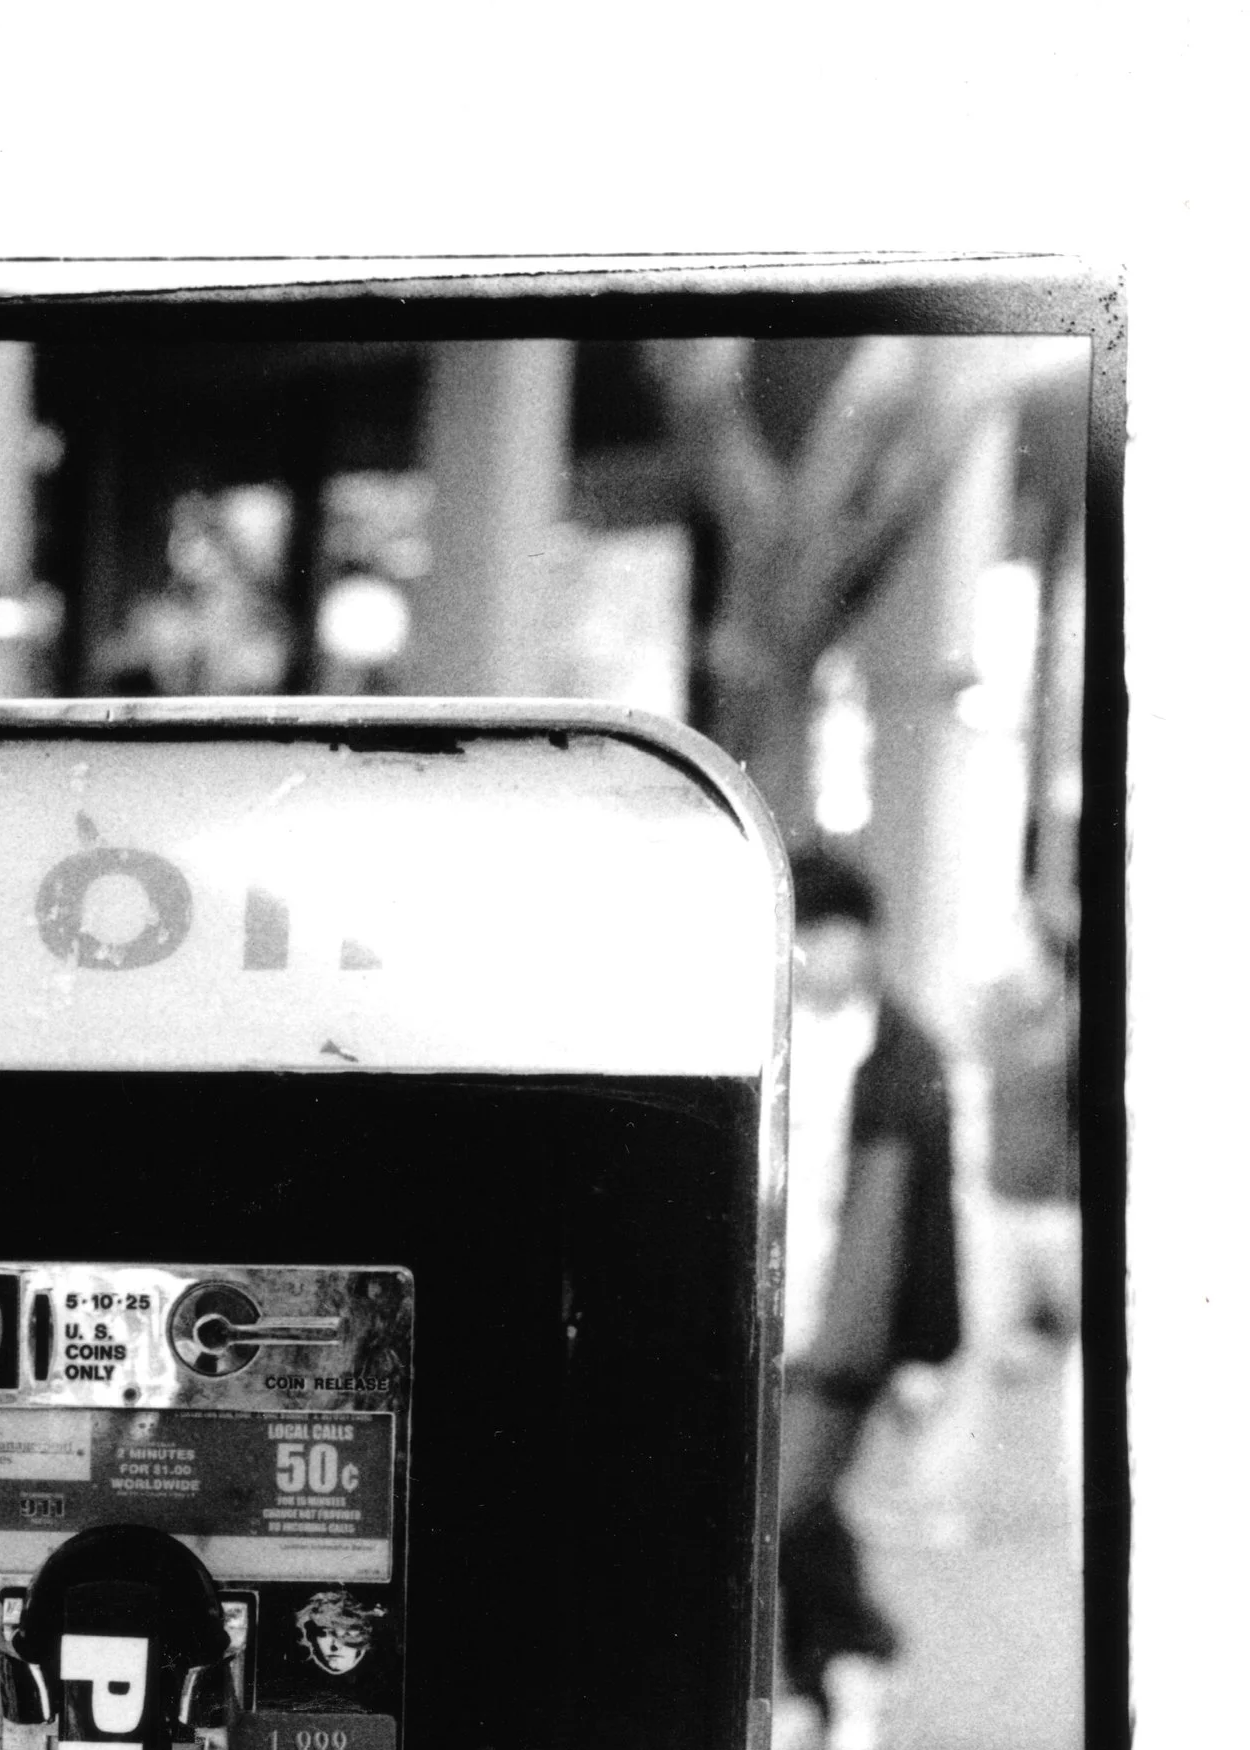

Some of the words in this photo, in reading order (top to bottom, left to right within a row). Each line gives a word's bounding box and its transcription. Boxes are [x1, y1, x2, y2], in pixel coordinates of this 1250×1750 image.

[65, 1344, 127, 1360] COINS
[65, 1364, 116, 1380] ONLY
[264, 1376, 306, 1391] COIN
[314, 1377, 389, 1392] RELEASE
[268, 1424, 309, 1440] LOCAL
[312, 1424, 354, 1441] CALLS
[129, 1448, 196, 1461] MINUTES
[119, 1463, 150, 1475] FOR
[110, 1478, 201, 1492] WORLDWIDE
